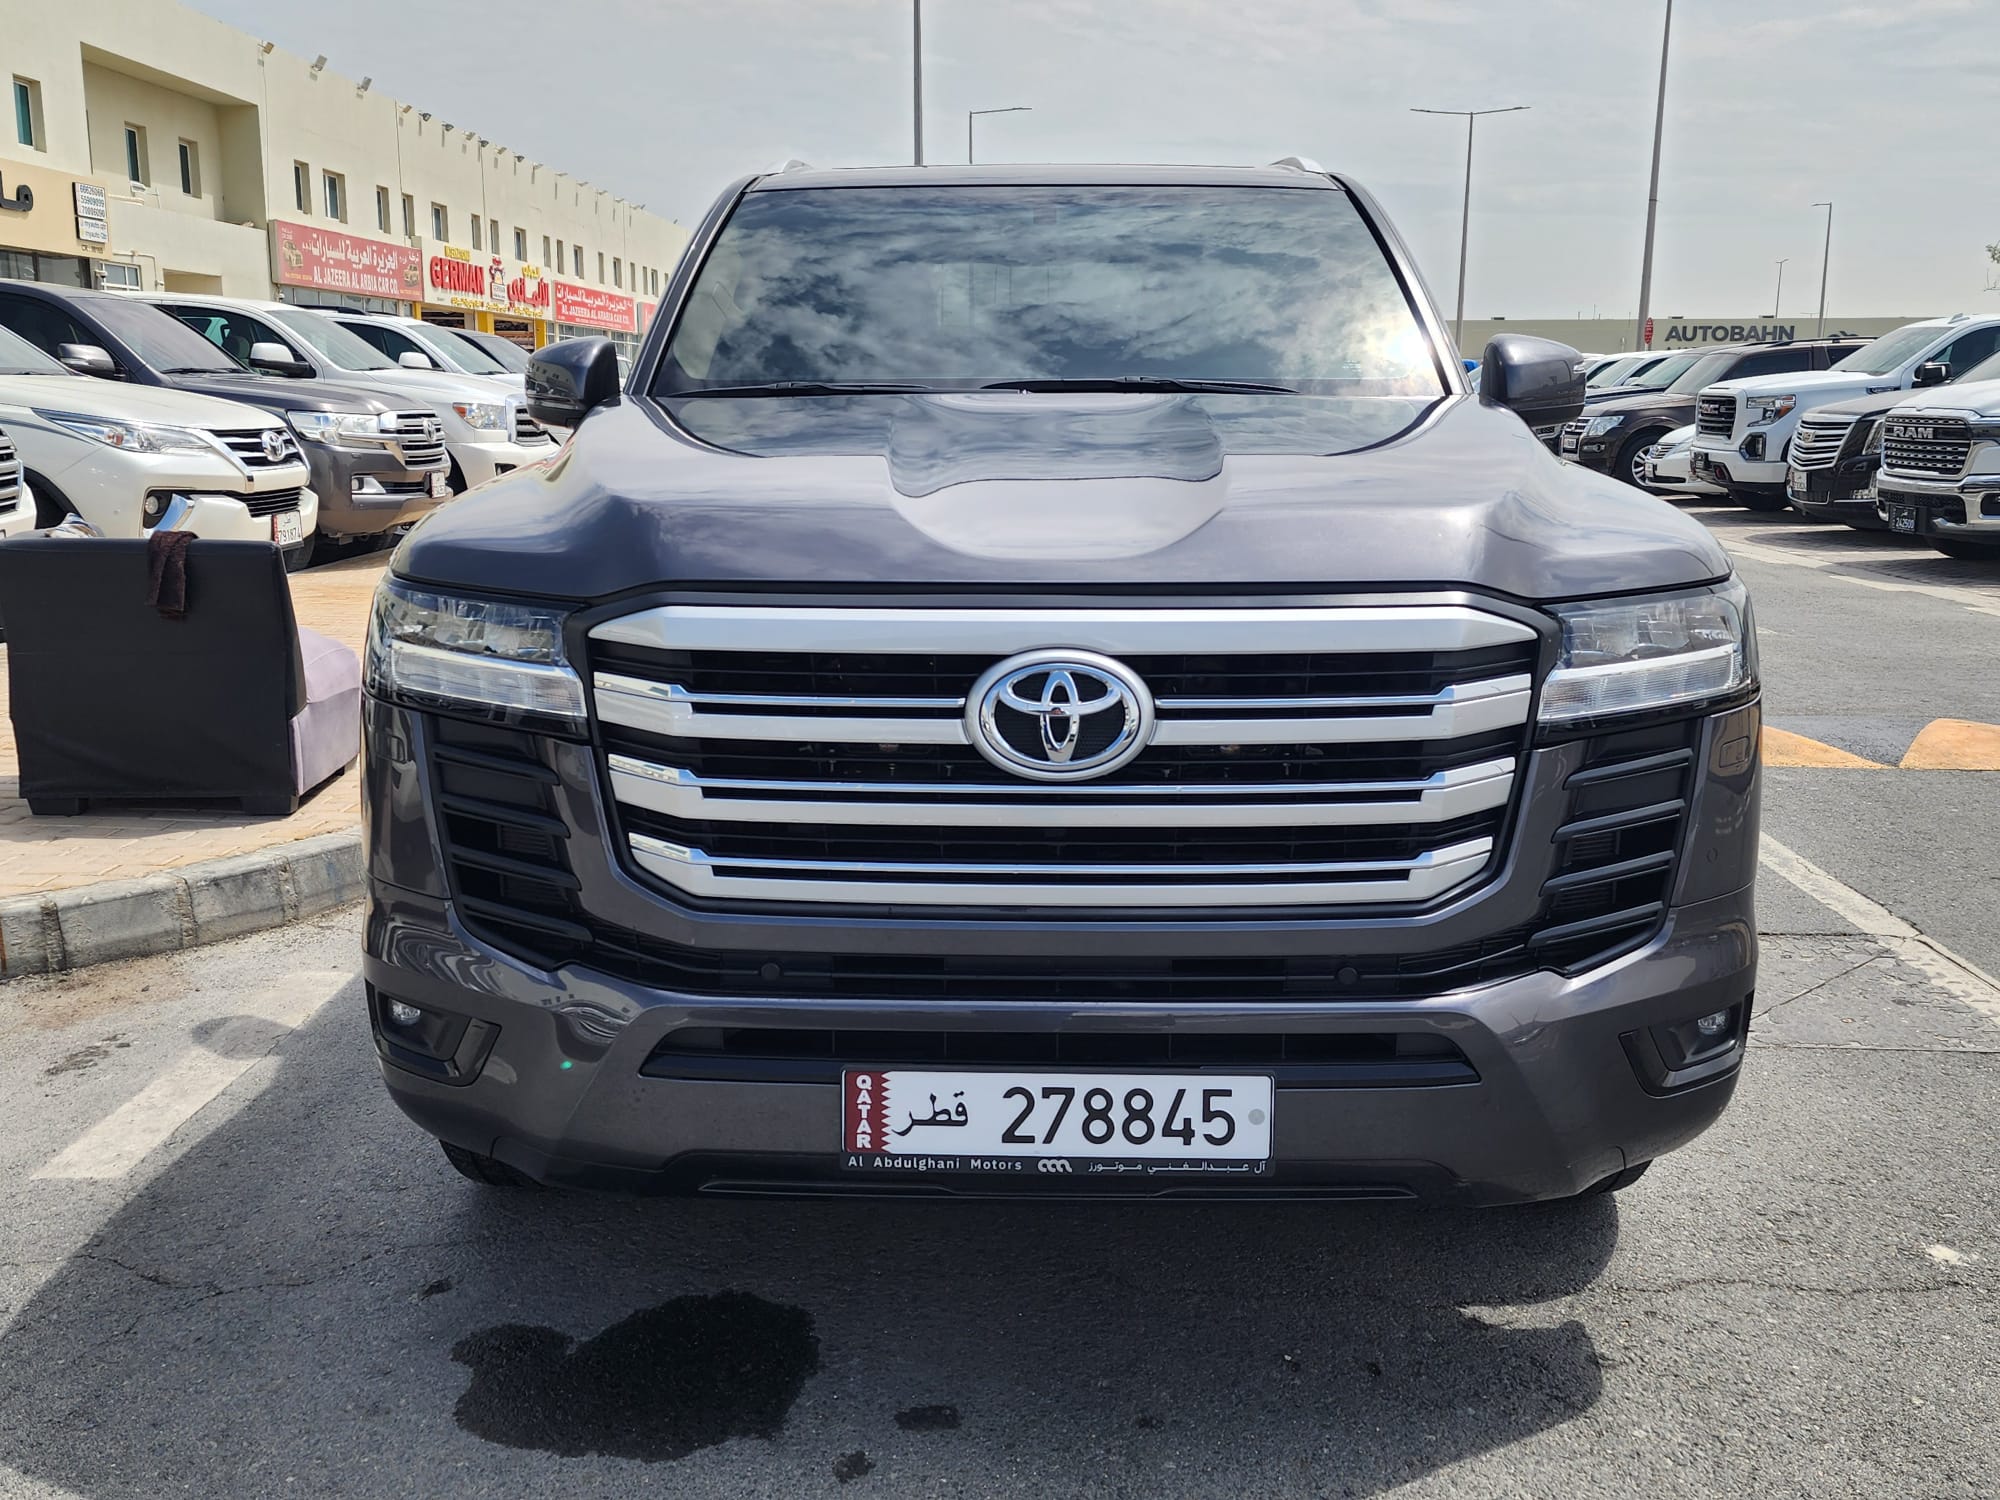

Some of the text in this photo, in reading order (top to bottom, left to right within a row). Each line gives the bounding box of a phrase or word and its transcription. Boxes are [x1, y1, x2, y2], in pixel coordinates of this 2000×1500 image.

[311, 233, 346, 265] للسيارات
[345, 239, 372, 269] العربية
[372, 245, 398, 275] الجزيرة
[313, 265, 323, 284] AL
[323, 267, 351, 289] JAZEERA
[351, 272, 360, 289] AL
[378, 276, 389, 294] CAR
[430, 256, 485, 296] GERMAN
[1664, 325, 1795, 342] AUTOBAHN
[1893, 426, 1934, 439] RAM
[856, 1074, 873, 1149] QATAR
[891, 1090, 969, 1137] قطر
[1001, 1086, 1236, 1146] 278845
[848, 1156, 1022, 1171] Al Abdulghani Motors
[1088, 1160, 1142, 1172] موتورز
[1254, 1160, 1266, 1174] آل
